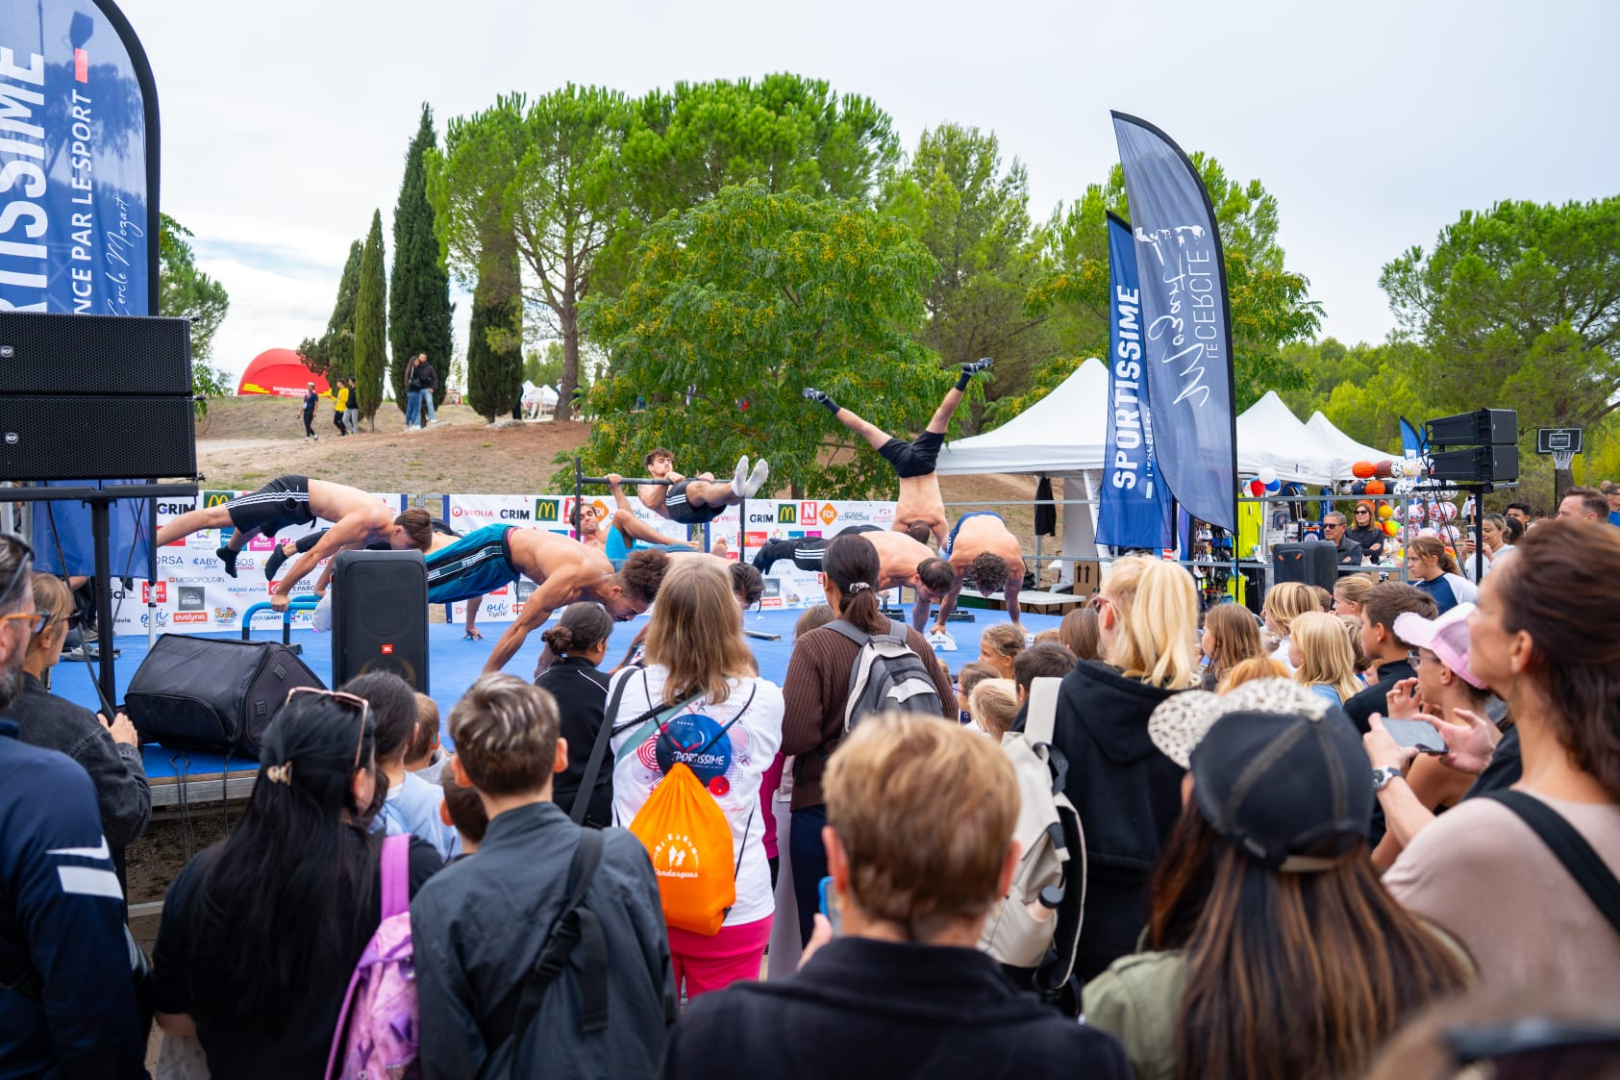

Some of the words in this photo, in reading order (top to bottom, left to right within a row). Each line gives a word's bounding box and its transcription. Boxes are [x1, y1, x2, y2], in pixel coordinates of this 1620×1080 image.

[72, 90, 92, 172] SPORT
[72, 176, 92, 205] LE
[72, 213, 92, 261] PAR
[106, 198, 143, 267] Mozart
[1112, 285, 1141, 490] SPORTISSIME
[157, 503, 195, 514] GRIM
[500, 509, 530, 520] GRIM
[750, 514, 774, 523] GRIM
[199, 557, 218, 565] ABY
[175, 576, 224, 584] METROPOLITAN
